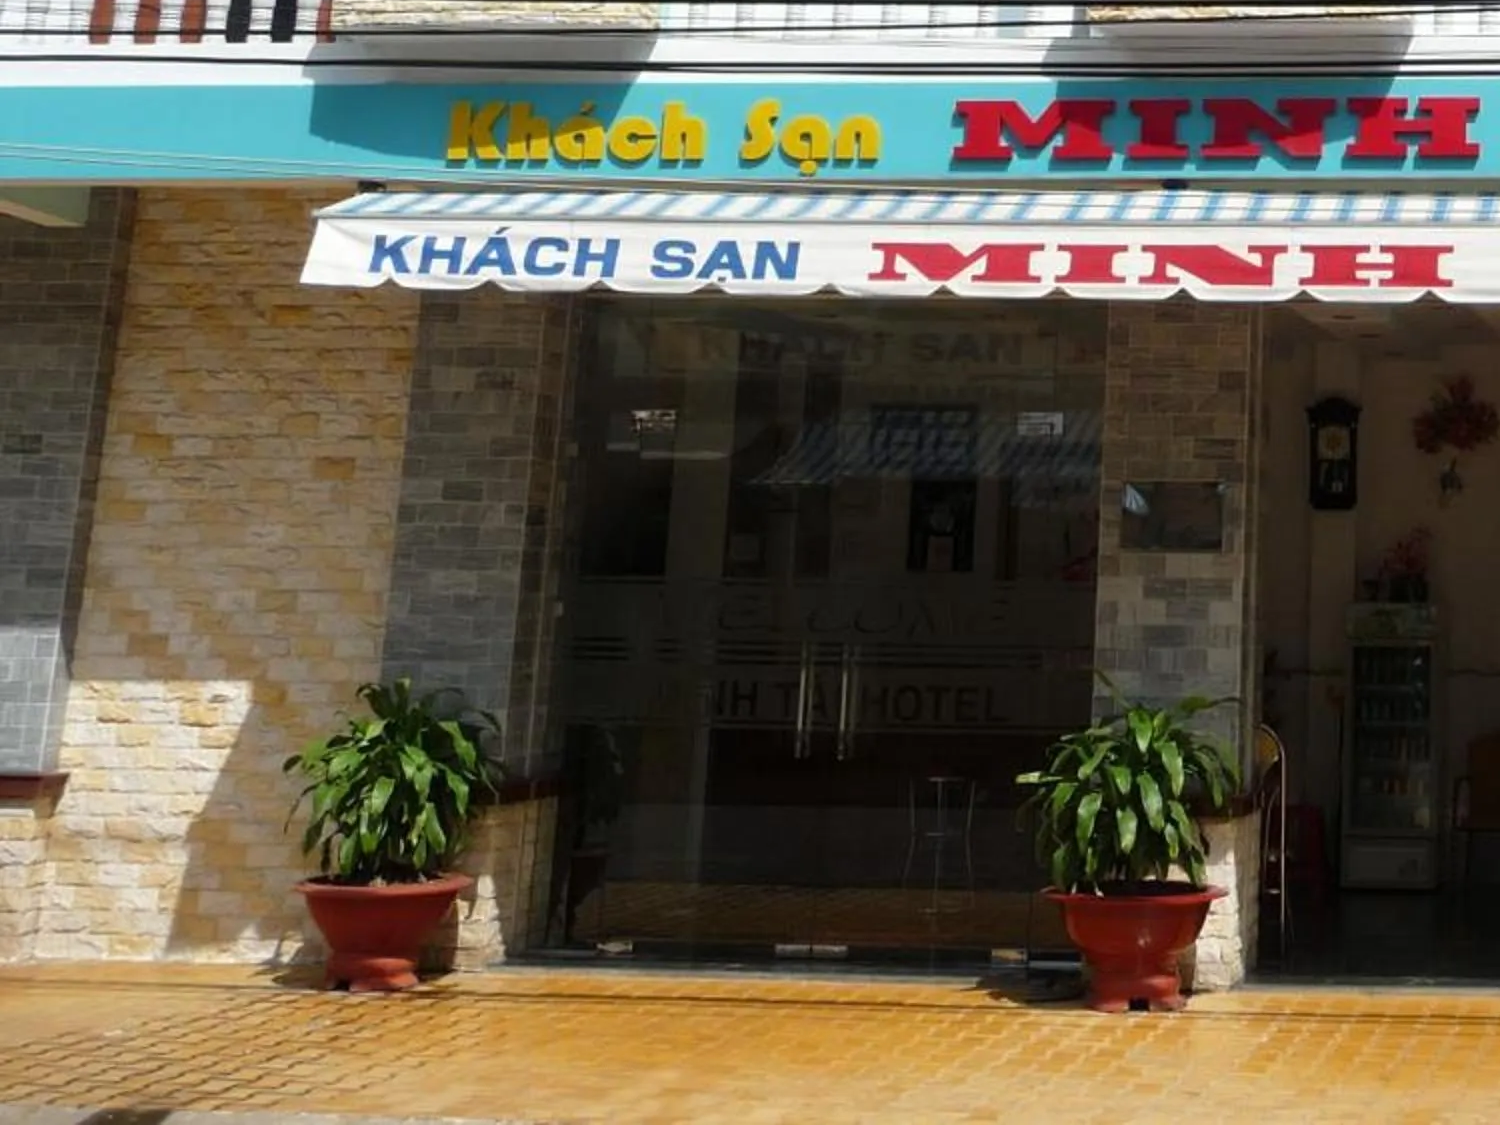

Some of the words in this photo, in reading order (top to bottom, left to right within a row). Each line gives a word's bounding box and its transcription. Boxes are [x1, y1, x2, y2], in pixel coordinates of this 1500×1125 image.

[446, 101, 706, 161] Khách
[740, 98, 881, 176] Sạn
[952, 98, 1479, 160] MINH
[369, 230, 619, 279] KHÁCH
[651, 239, 799, 283] SẠN
[868, 242, 1454, 288] MINH
[862, 683, 1012, 723] HOTEL
